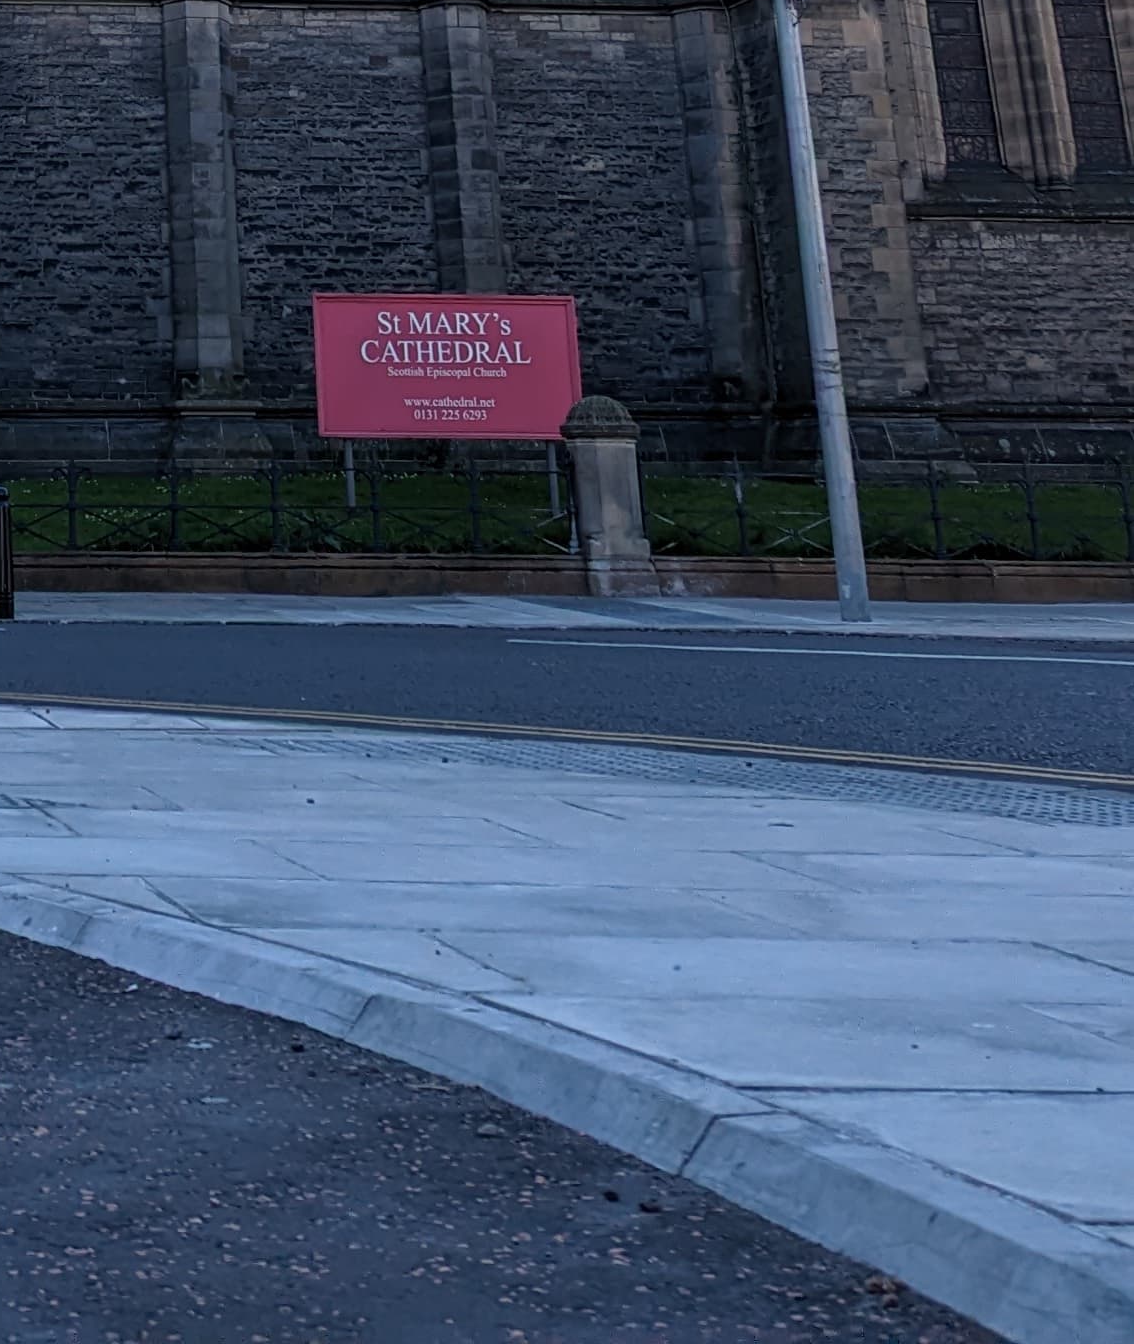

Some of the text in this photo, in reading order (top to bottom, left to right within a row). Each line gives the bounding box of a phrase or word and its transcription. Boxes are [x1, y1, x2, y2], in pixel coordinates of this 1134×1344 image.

[377, 311, 401, 334] St
[360, 340, 532, 364] CATHEDRAL
[387, 366, 507, 379] Scottish Episcopal Church
[403, 396, 496, 408] www.cathedral.net
[413, 409, 487, 421] 0131 225 6293
